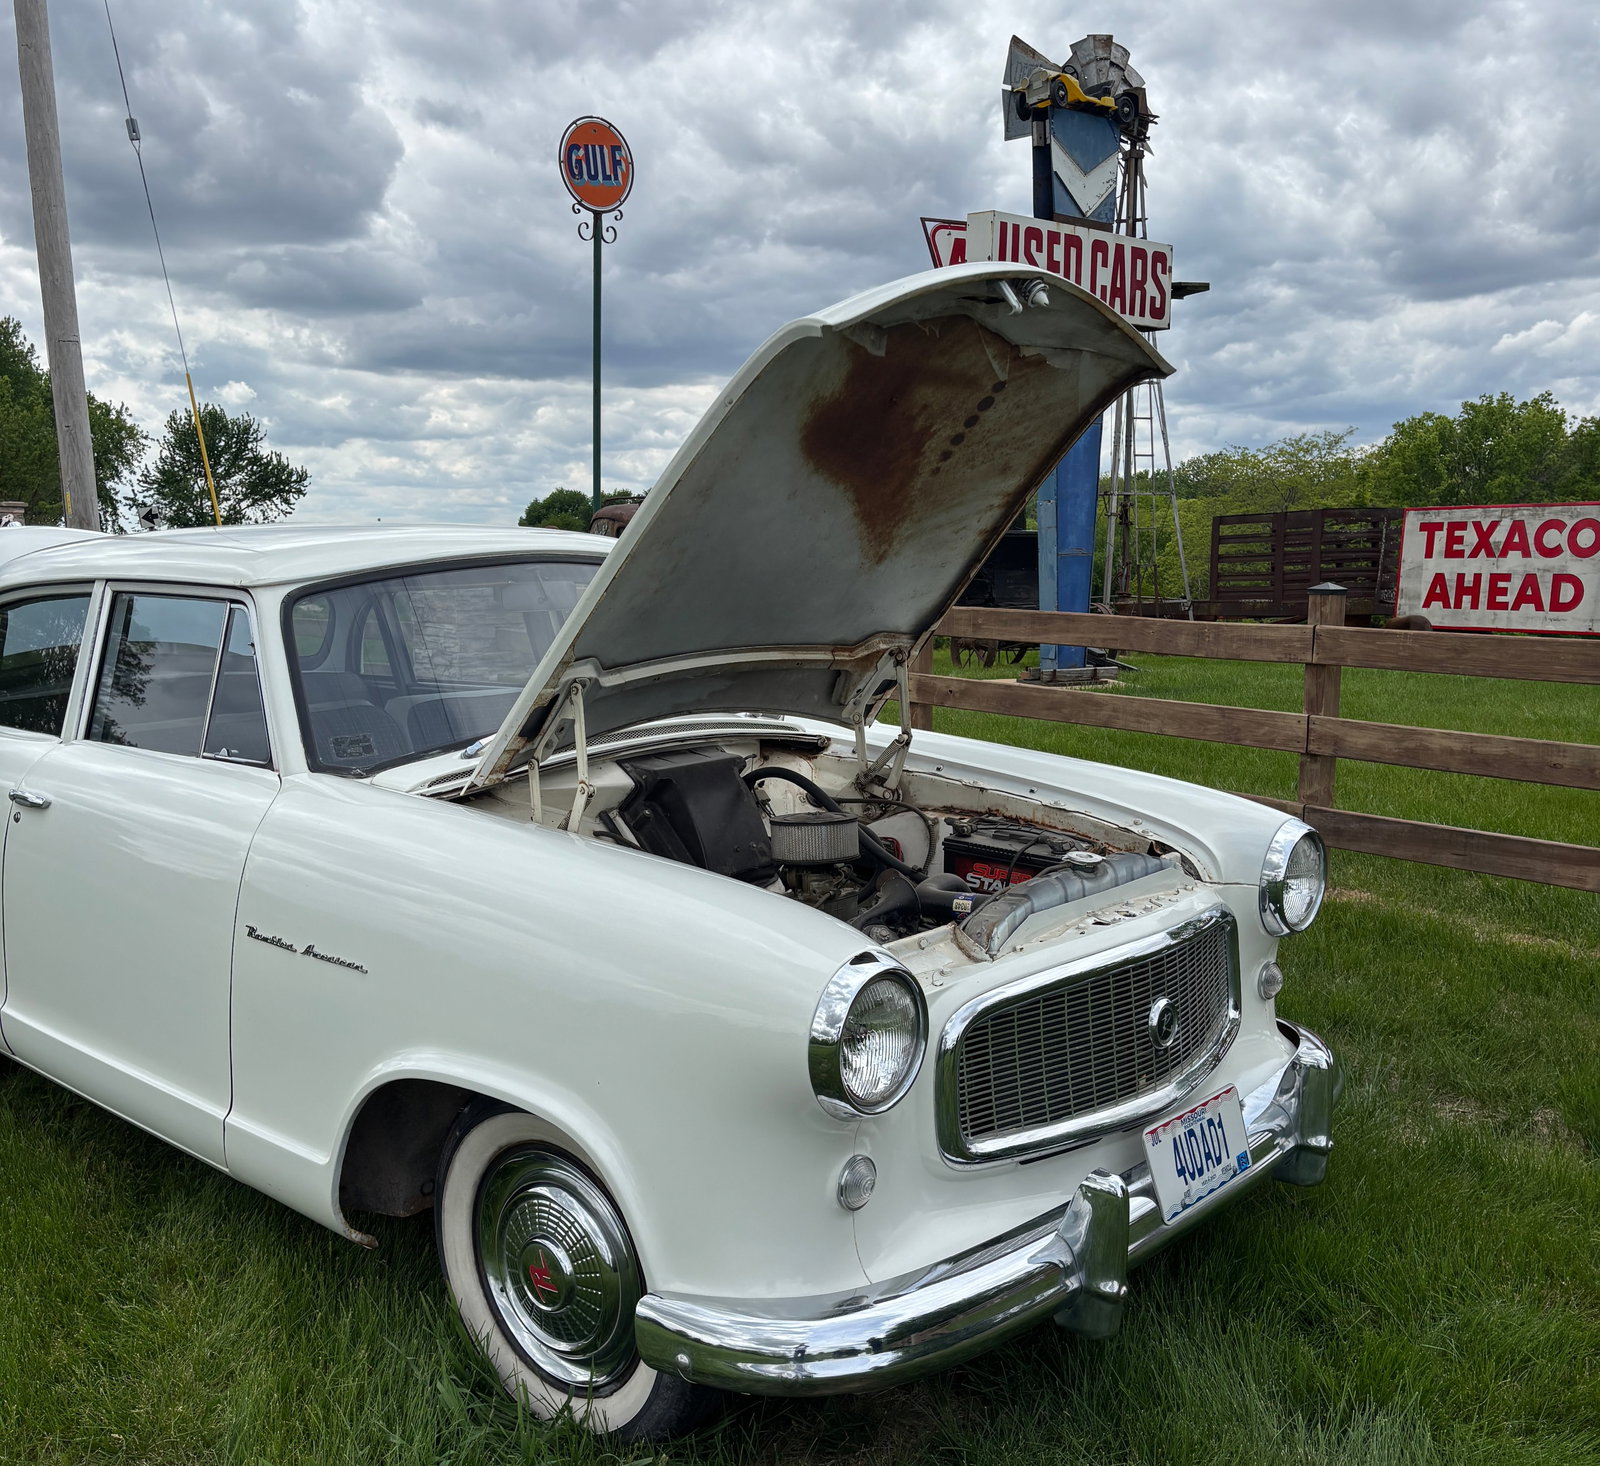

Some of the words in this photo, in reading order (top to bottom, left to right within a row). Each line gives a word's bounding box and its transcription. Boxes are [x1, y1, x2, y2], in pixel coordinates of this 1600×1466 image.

[567, 144, 625, 186] GULF
[998, 221, 1082, 287] USED
[1091, 238, 1169, 321] CARS
[1419, 518, 1600, 559] TEXACO
[1422, 573, 1585, 613] AHEAD
[966, 873, 1016, 891] STA
[1180, 1107, 1207, 1127] MISSOURI
[1172, 1112, 1230, 1186] 4UDAD1
